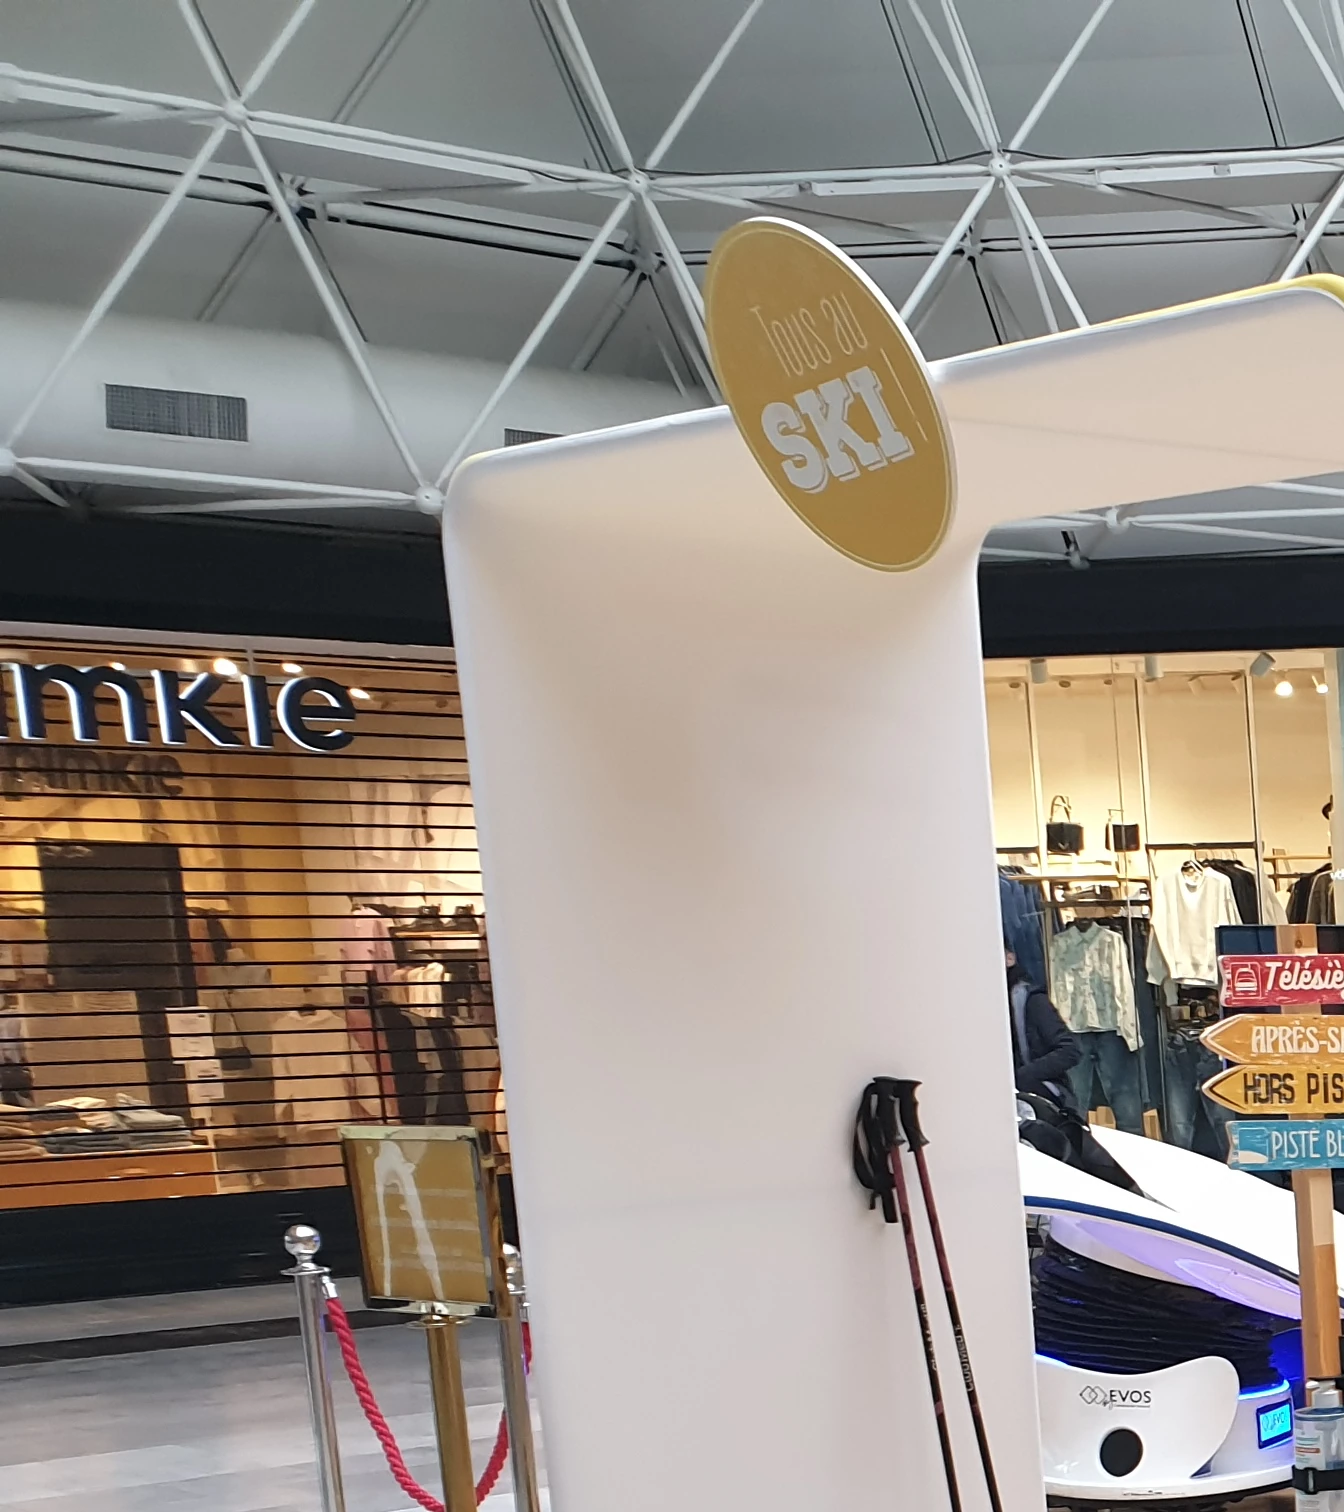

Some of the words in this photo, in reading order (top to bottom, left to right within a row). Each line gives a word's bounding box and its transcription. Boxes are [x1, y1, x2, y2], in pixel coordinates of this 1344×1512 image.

[749, 305, 832, 377] Tous
[821, 291, 868, 356] au
[761, 366, 915, 494] SKI
[1243, 1073, 1295, 1104] HORS
[1271, 1130, 1320, 1160] PISTE
[1109, 1389, 1152, 1403] EVOS
